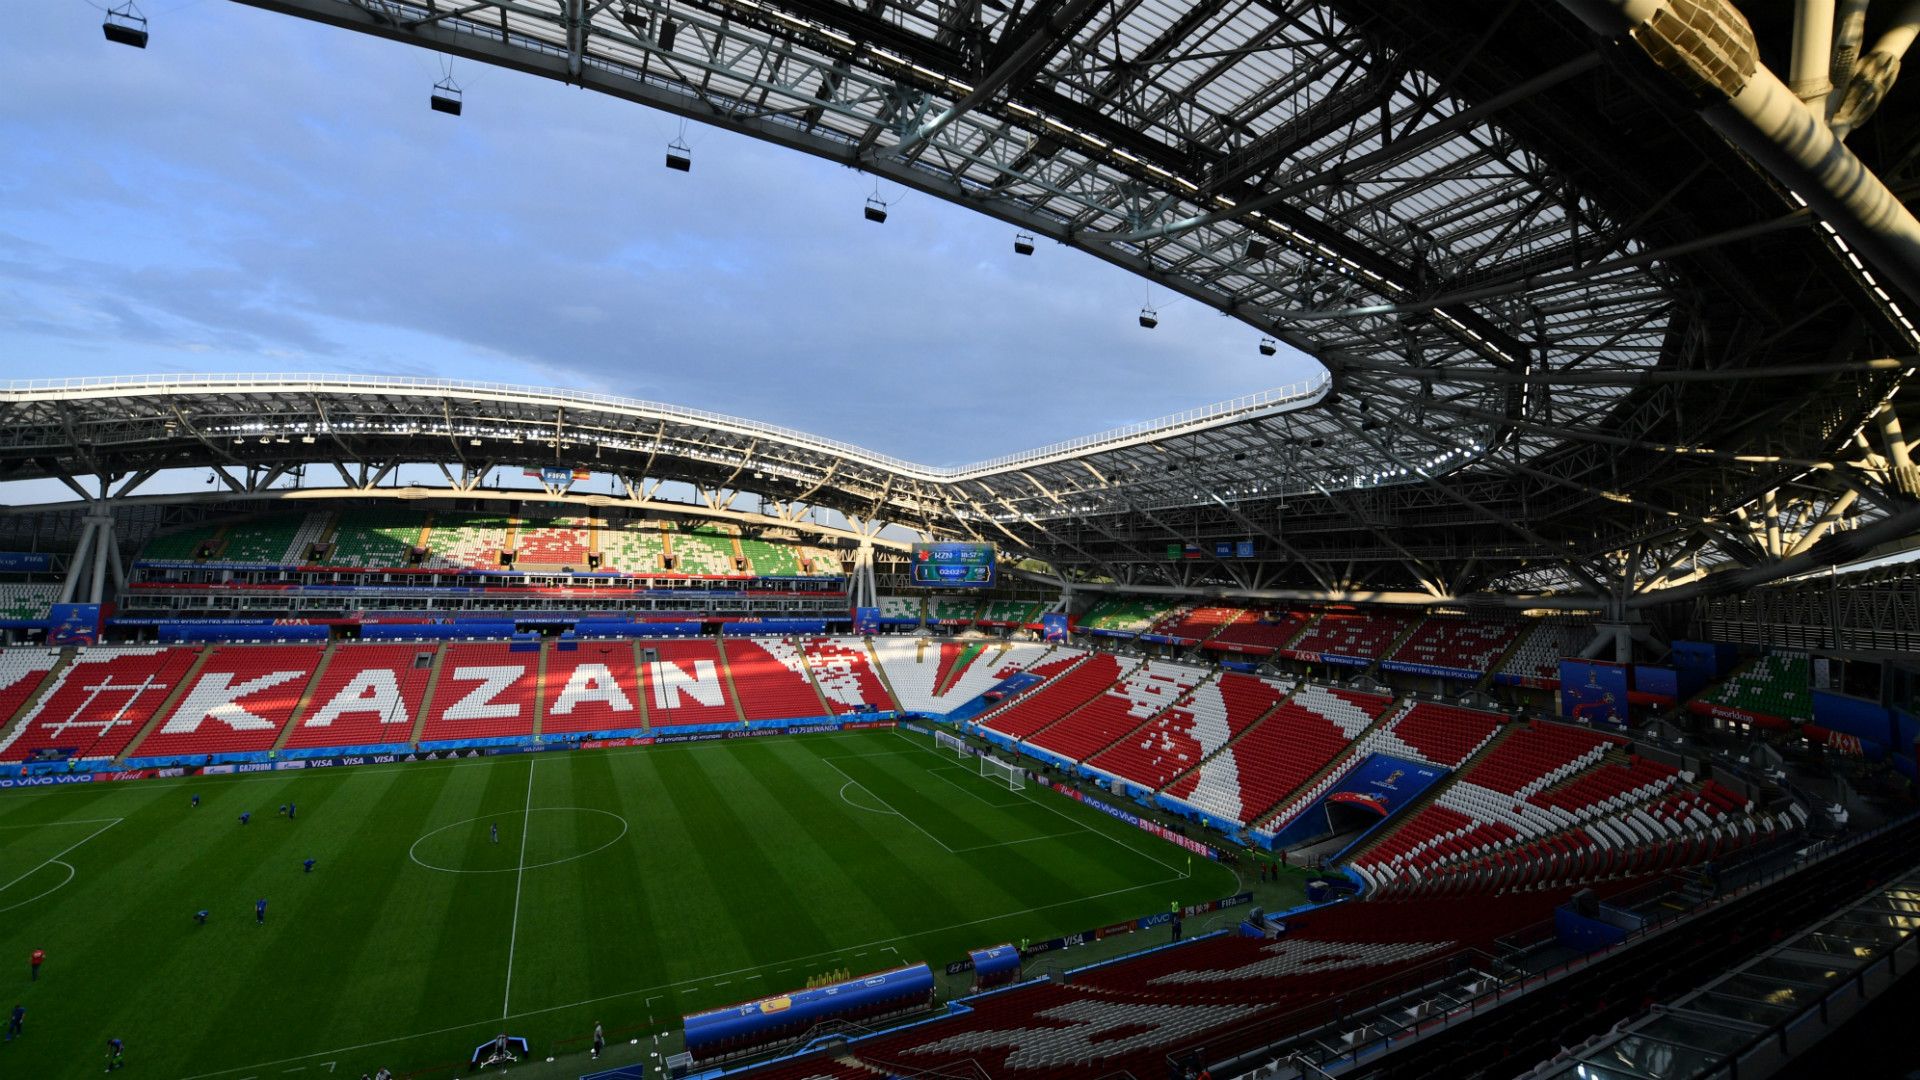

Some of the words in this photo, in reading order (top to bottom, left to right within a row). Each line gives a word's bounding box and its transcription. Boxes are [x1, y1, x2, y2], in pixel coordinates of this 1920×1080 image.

[547, 472, 567, 480] FIFA
[1711, 706, 1754, 723] #worldcup
[727, 729, 749, 738] QATAR
[750, 728, 779, 737] AIRWAYS
[311, 759, 333, 768] VISA
[343, 757, 364, 765] VISA
[373, 755, 395, 763] VISA
[112, 770, 143, 781] Bud
[1147, 913, 1170, 925] vivo
[1063, 933, 1084, 947] VISA
